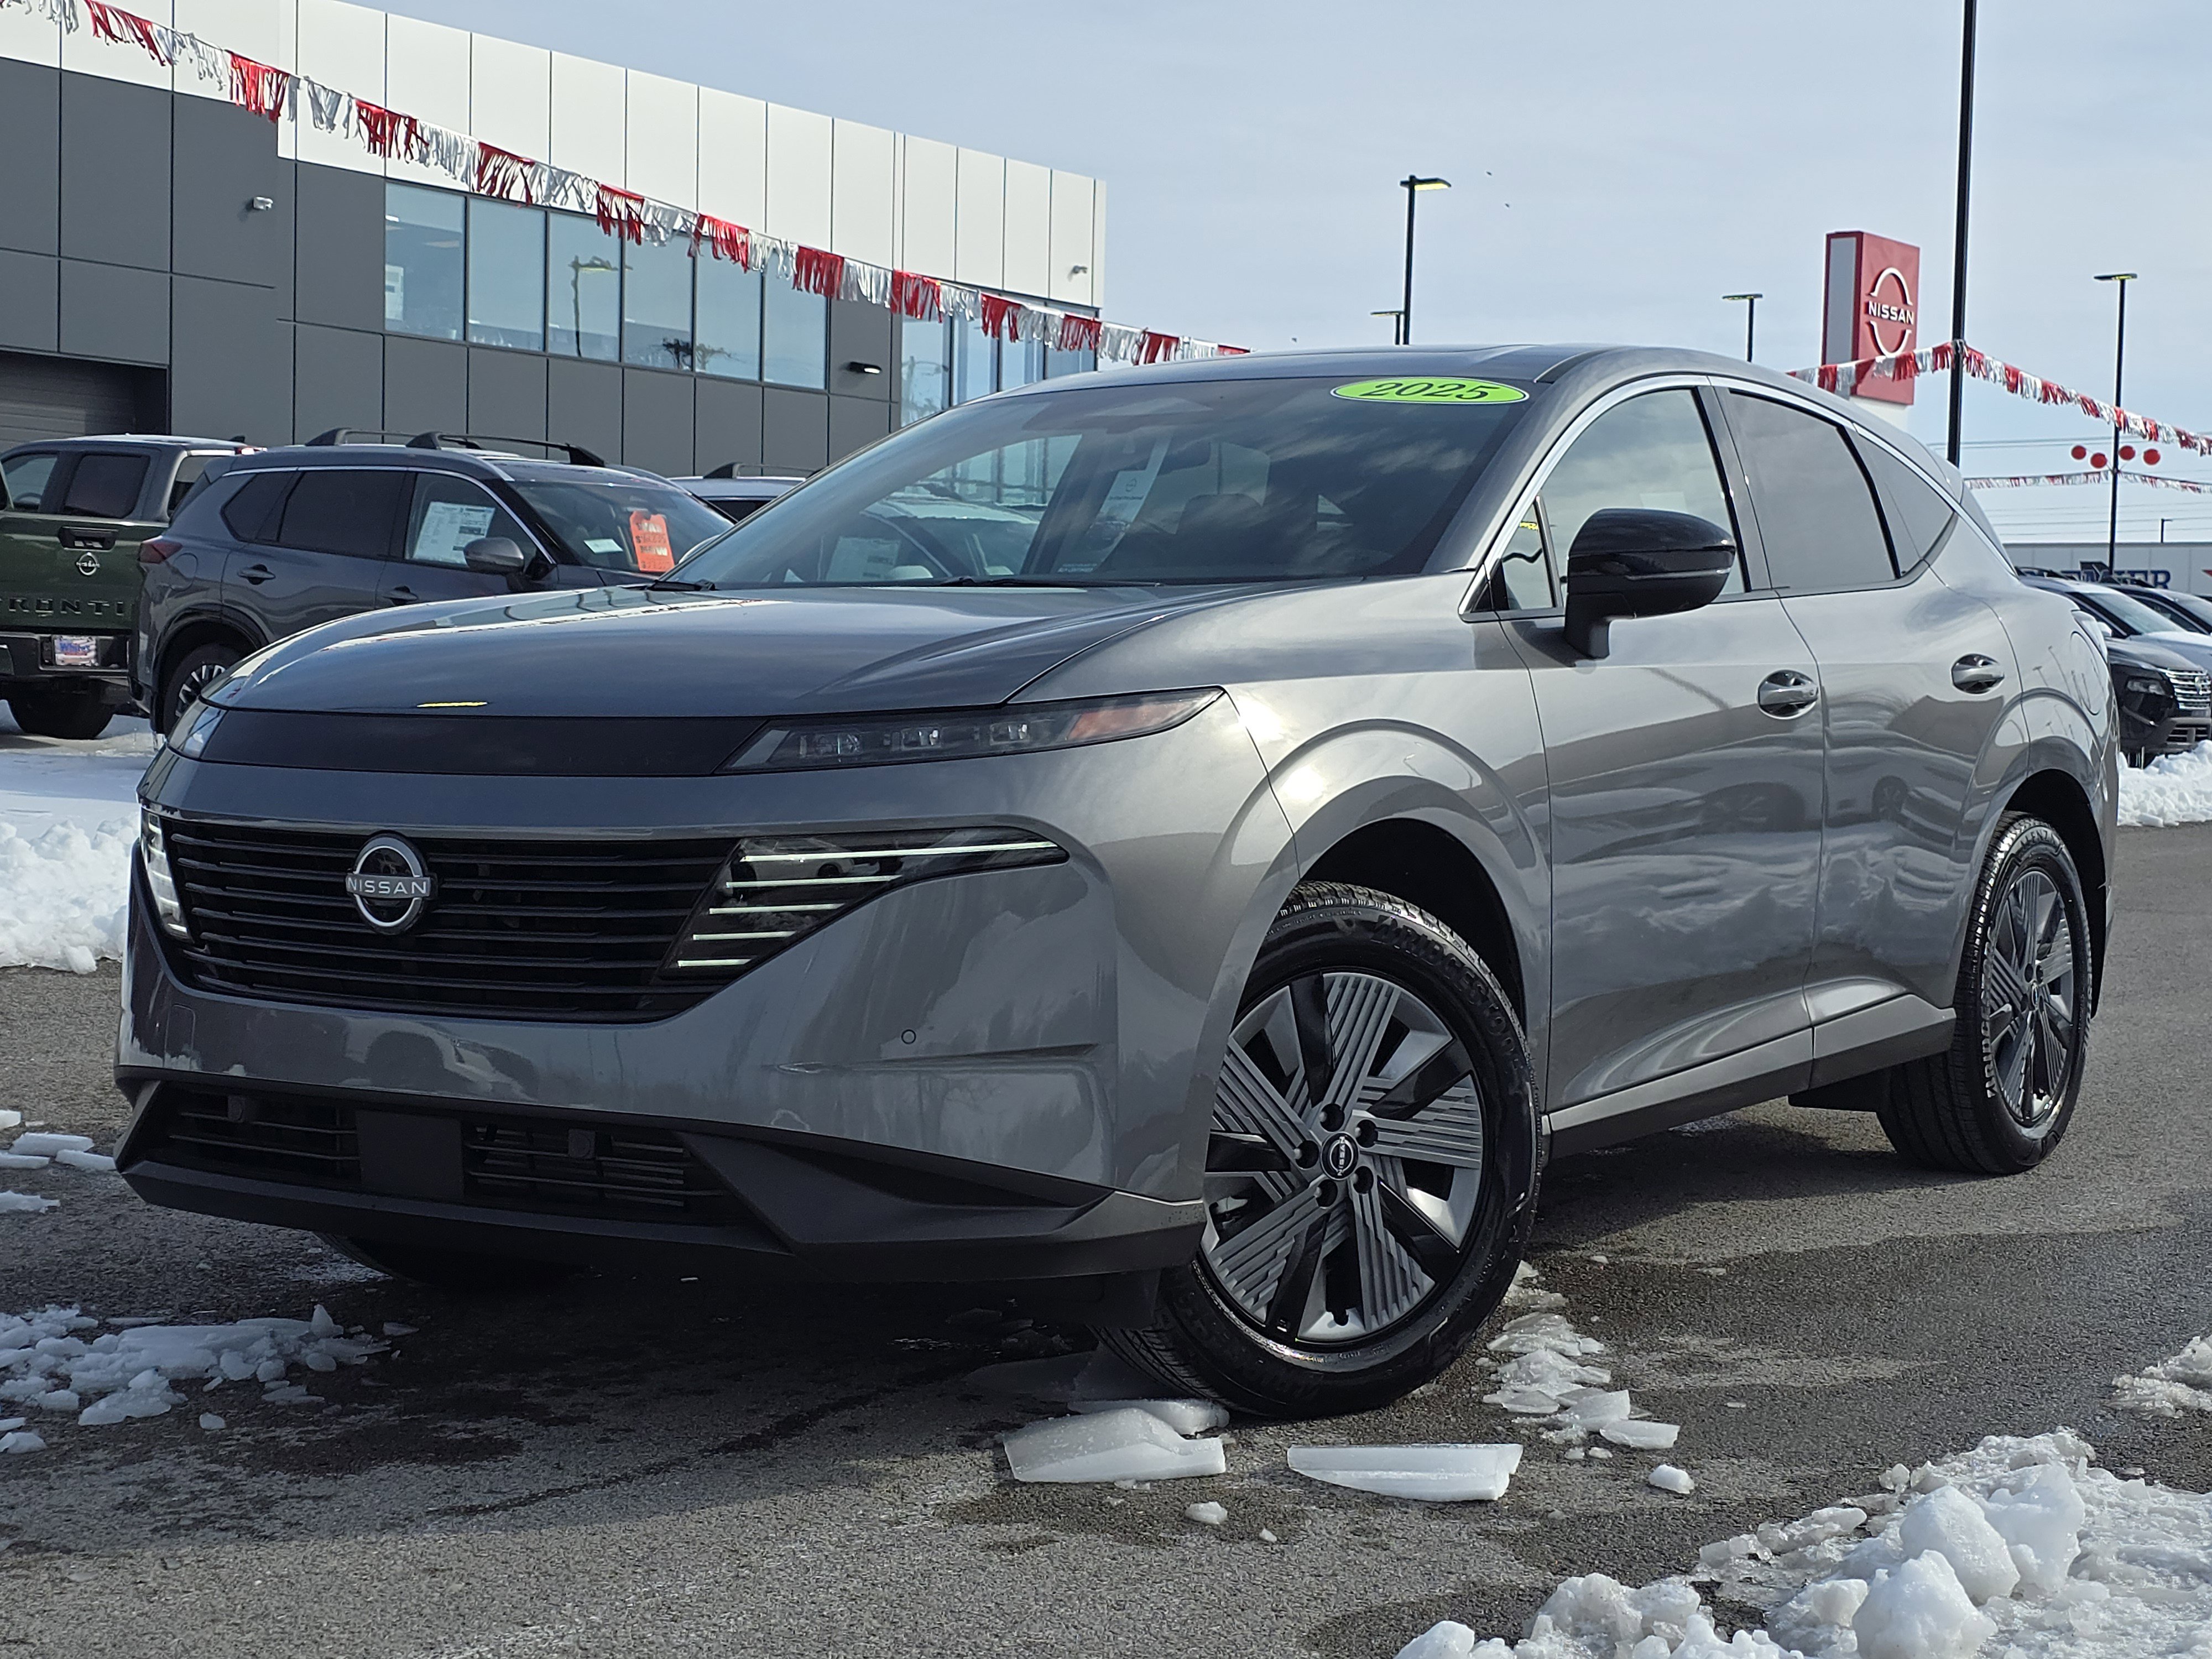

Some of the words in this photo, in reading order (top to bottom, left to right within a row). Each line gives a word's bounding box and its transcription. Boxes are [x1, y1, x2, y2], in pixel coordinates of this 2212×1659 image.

[1869, 301, 1914, 325] NISSAN
[1359, 382, 1501, 400] 2025
[0, 597, 124, 616] RONTI
[347, 877, 427, 895] NISSAN
[1337, 1136, 1345, 1176] NISSAN
